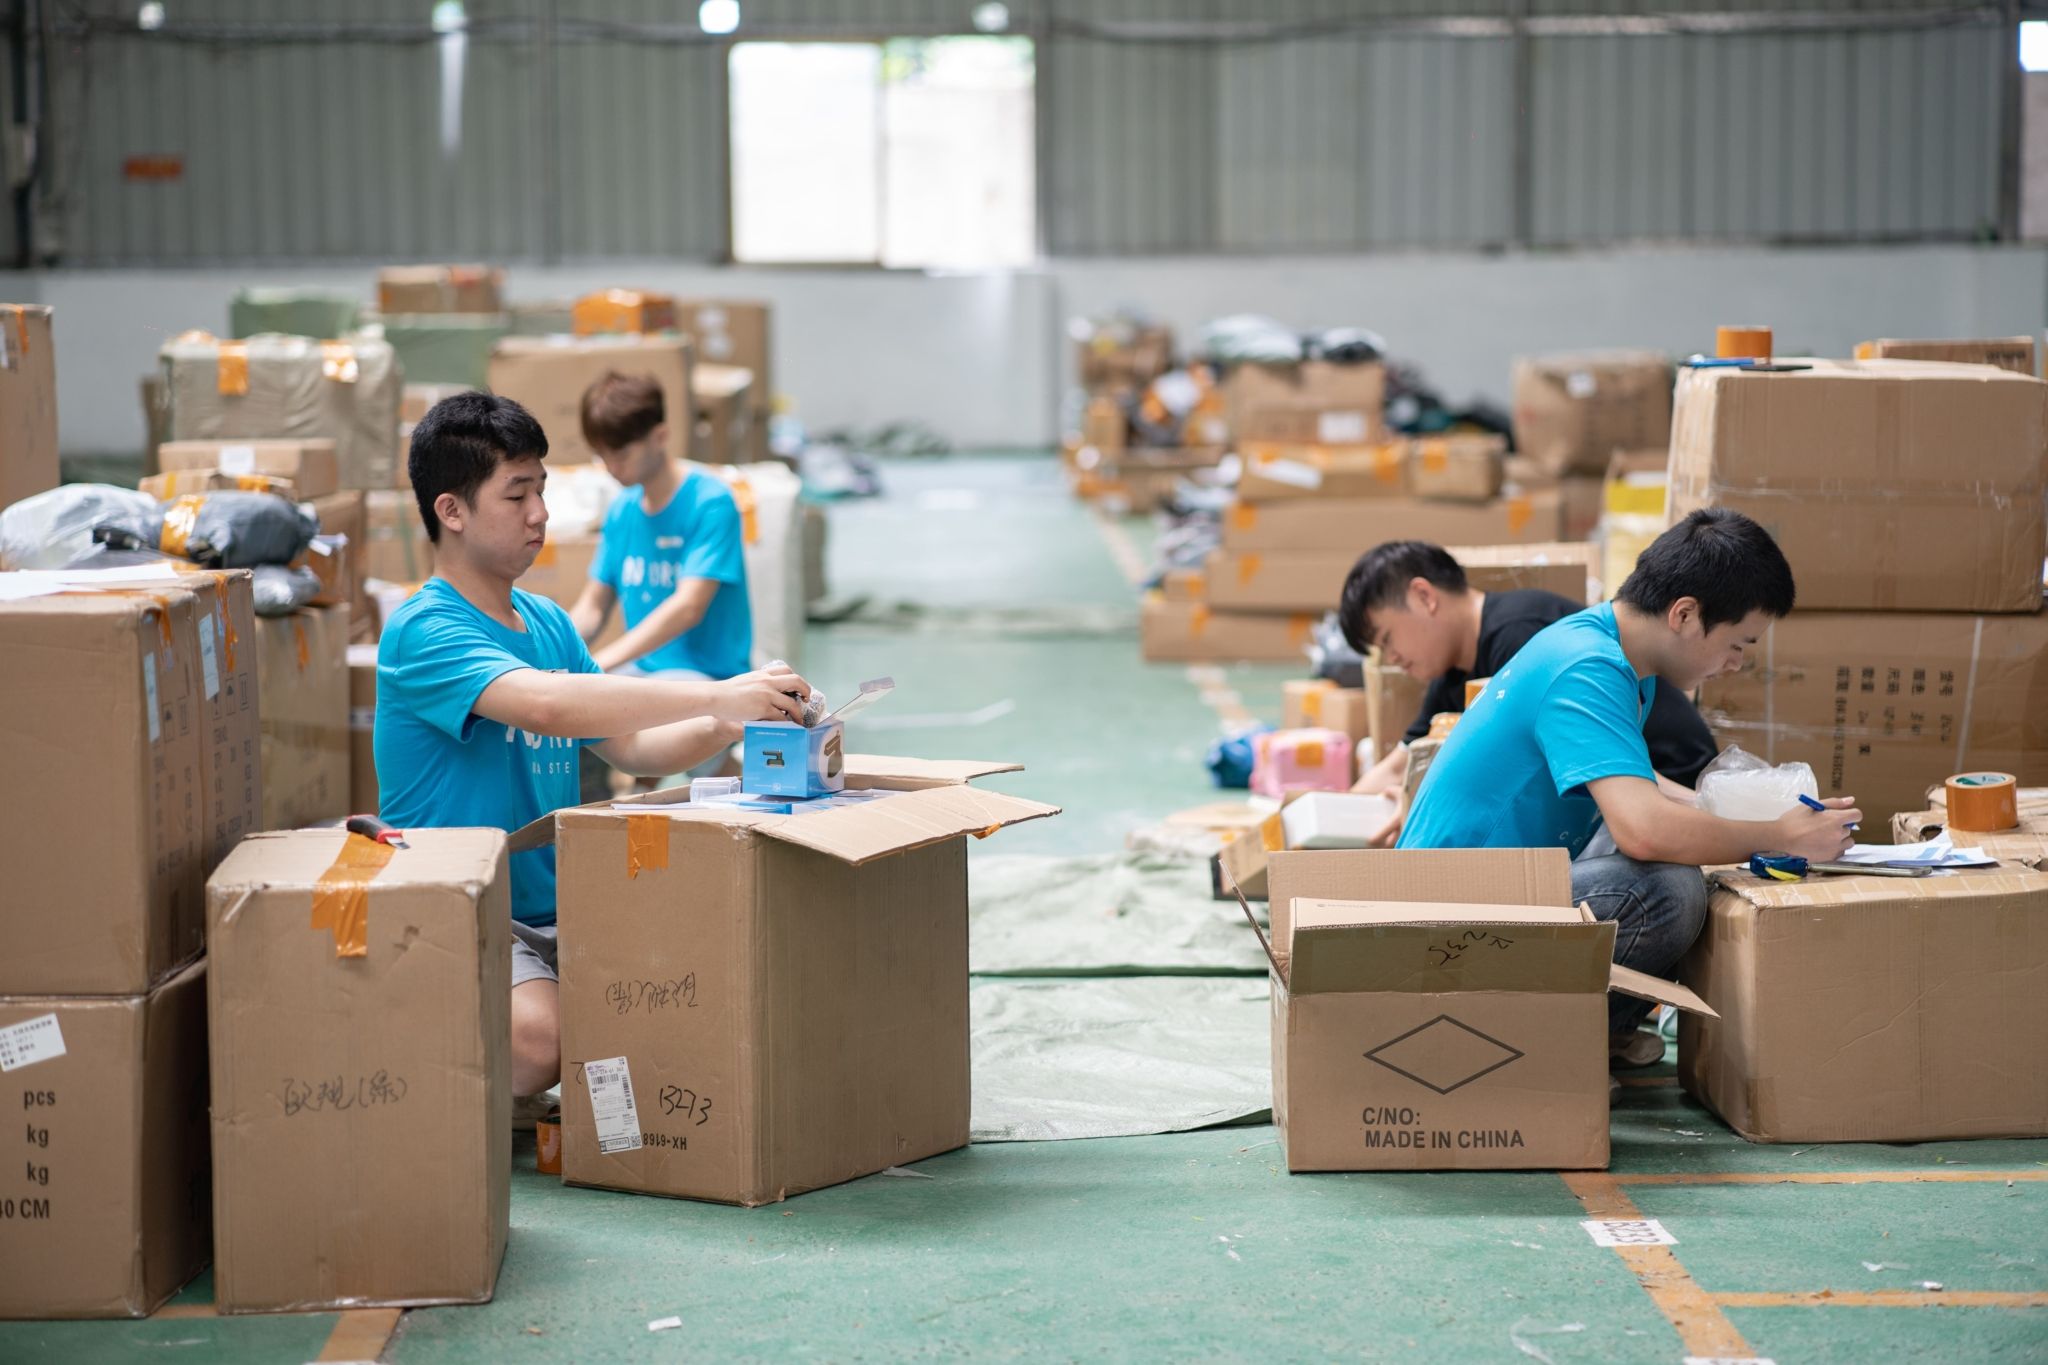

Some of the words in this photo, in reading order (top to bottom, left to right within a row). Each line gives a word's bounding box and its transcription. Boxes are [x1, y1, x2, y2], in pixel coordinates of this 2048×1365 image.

[24, 1089, 56, 1109] pcs
[1362, 1107, 1421, 1125] C/NO:
[27, 1123, 49, 1147] kg
[1365, 1130, 1426, 1148] MADE
[1431, 1130, 1451, 1149] IN
[1457, 1129, 1525, 1149] CHINA
[27, 1161, 49, 1185] kg
[20, 1198, 50, 1219] CM
